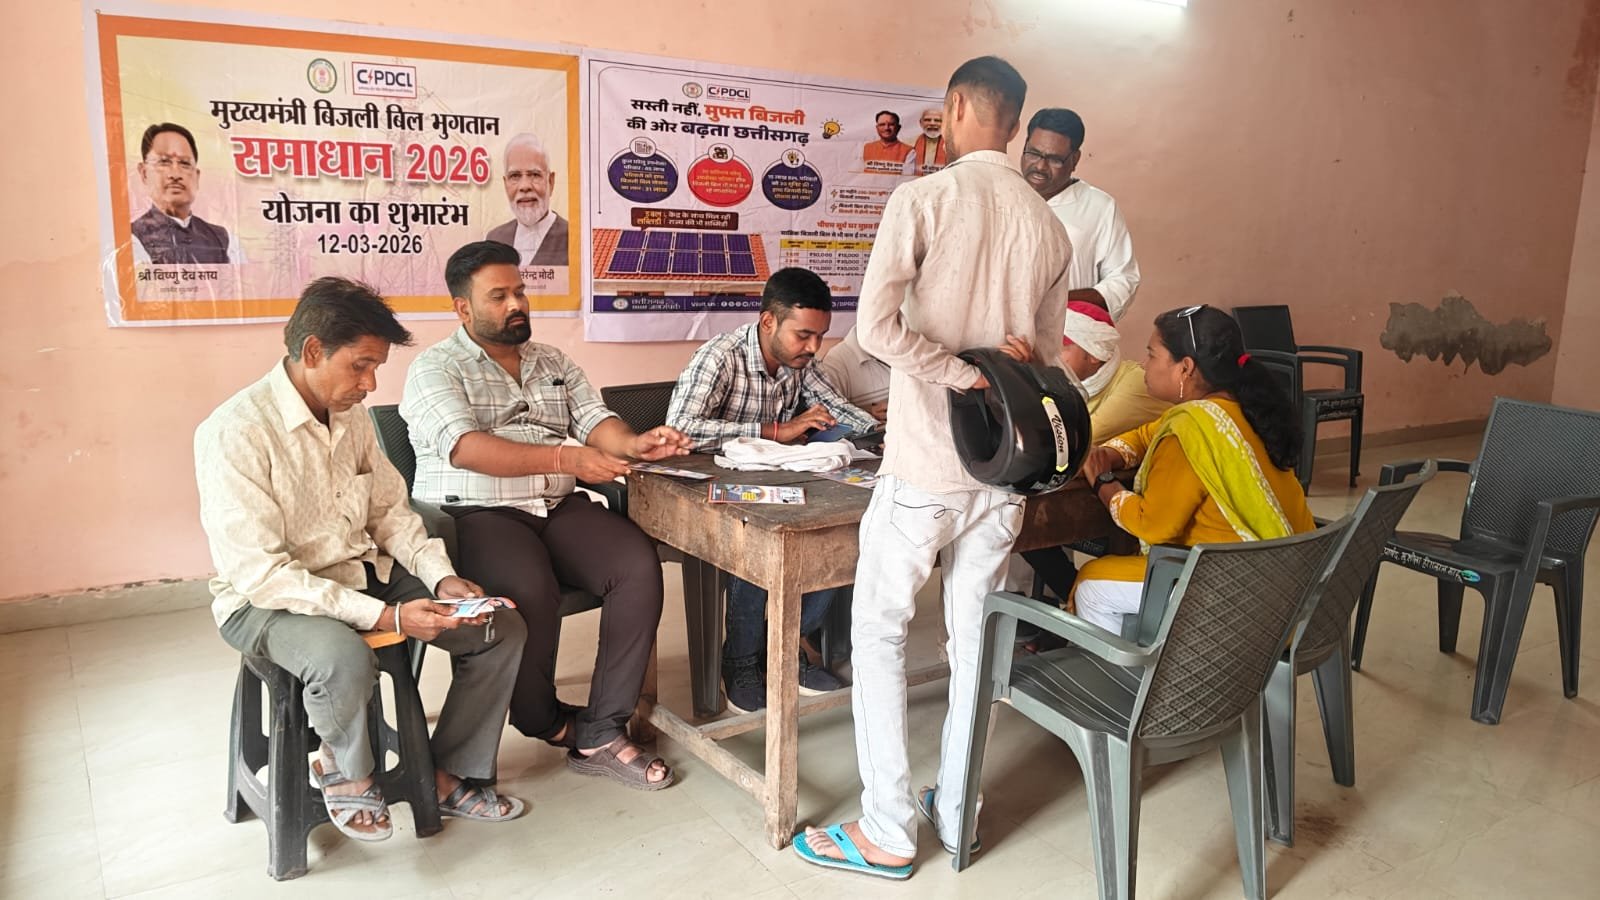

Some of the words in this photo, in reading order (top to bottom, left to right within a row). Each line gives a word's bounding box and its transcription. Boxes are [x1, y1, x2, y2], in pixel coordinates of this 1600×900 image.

[209, 97, 307, 129] मुख्यमंत्री
[313, 99, 379, 129] बिजली
[386, 104, 424, 131] बिल
[431, 113, 500, 140] भुगतान
[631, 99, 668, 112] सस्ती
[672, 102, 702, 117] नहीं,
[704, 104, 745, 122] मुफ्त
[749, 106, 806, 125] बिजली
[626, 117, 646, 130] की
[650, 119, 677, 133] ओर
[681, 121, 730, 139] बढ़ता
[733, 125, 810, 147] छत्तीसगढ़
[230, 137, 393, 179] समाधान
[406, 143, 490, 183] 2026
[262, 192, 341, 224] योजना
[349, 202, 380, 224] का
[388, 197, 469, 233] शुभारंभ
[317, 234, 423, 254] 12-03-2026
[138, 268, 151, 281] श्री
[153, 269, 180, 284] विष्णु
[181, 268, 196, 281] देव
[198, 270, 218, 281] साय
[538, 268, 554, 281] मोदी
[1051, 414, 1065, 453] Vision
